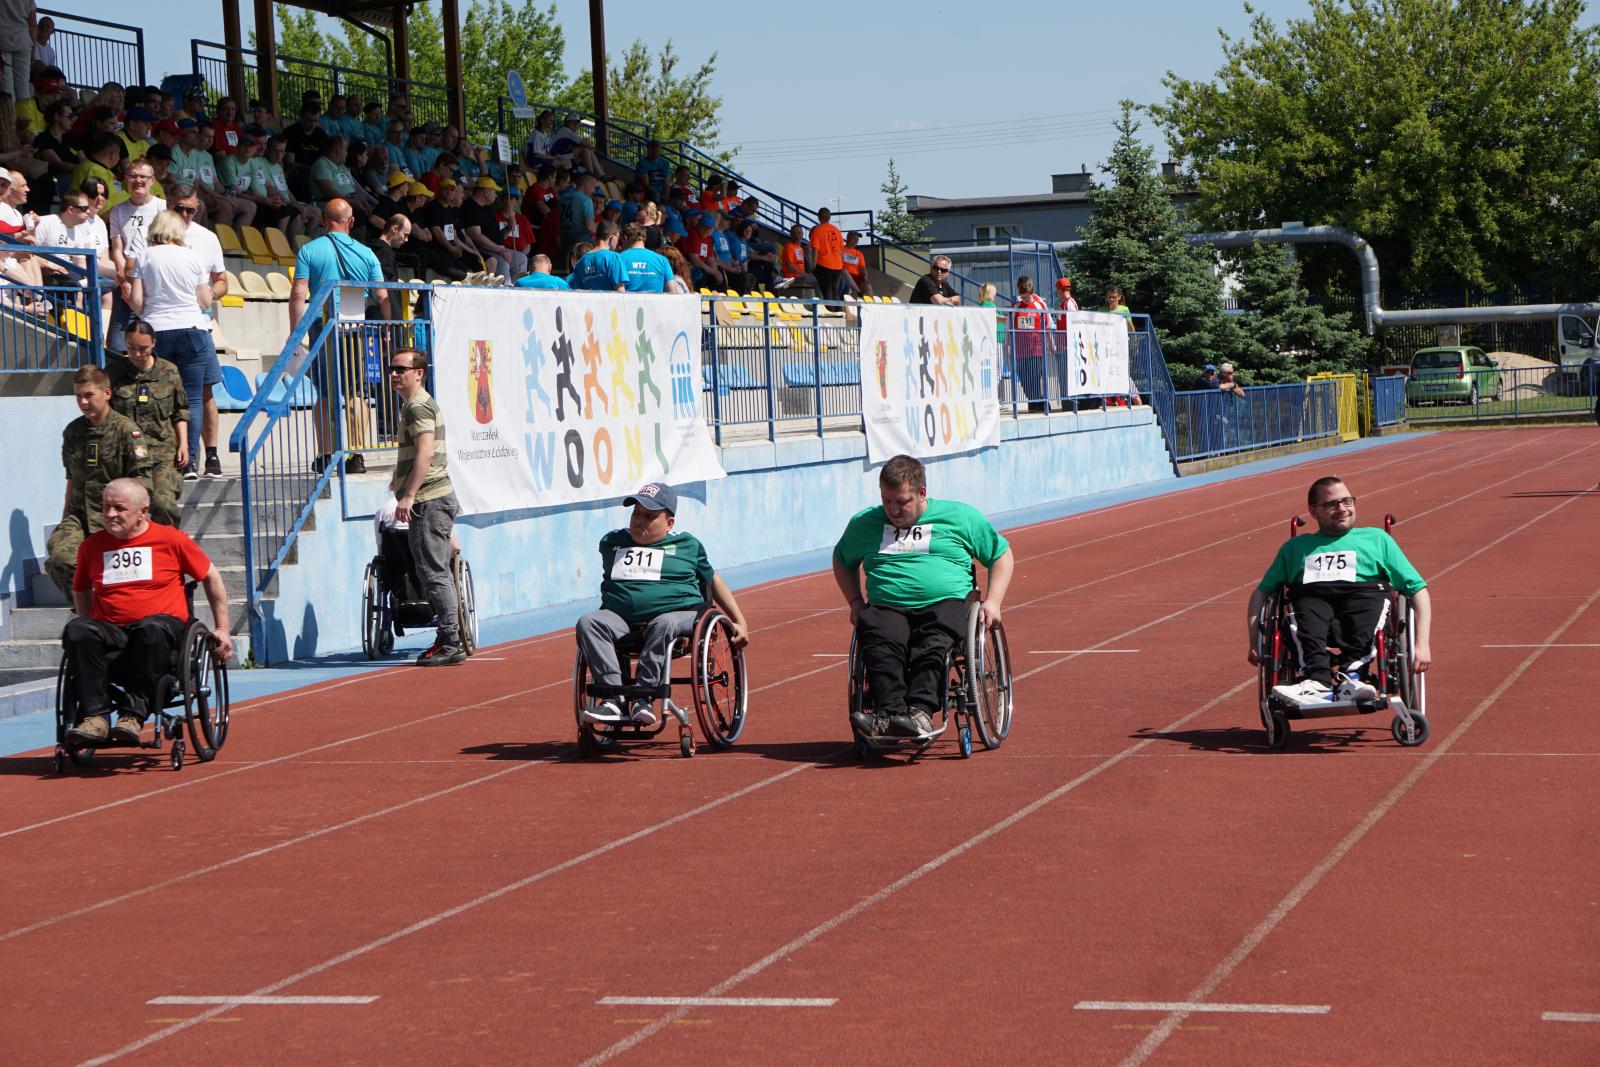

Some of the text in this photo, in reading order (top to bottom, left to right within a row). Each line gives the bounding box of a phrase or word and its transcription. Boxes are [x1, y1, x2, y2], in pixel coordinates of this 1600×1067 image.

[130, 215, 144, 227] 72
[632, 261, 647, 269] WTZ
[112, 550, 142, 569] 396
[623, 550, 653, 567] 511
[1314, 554, 1347, 571] 175
